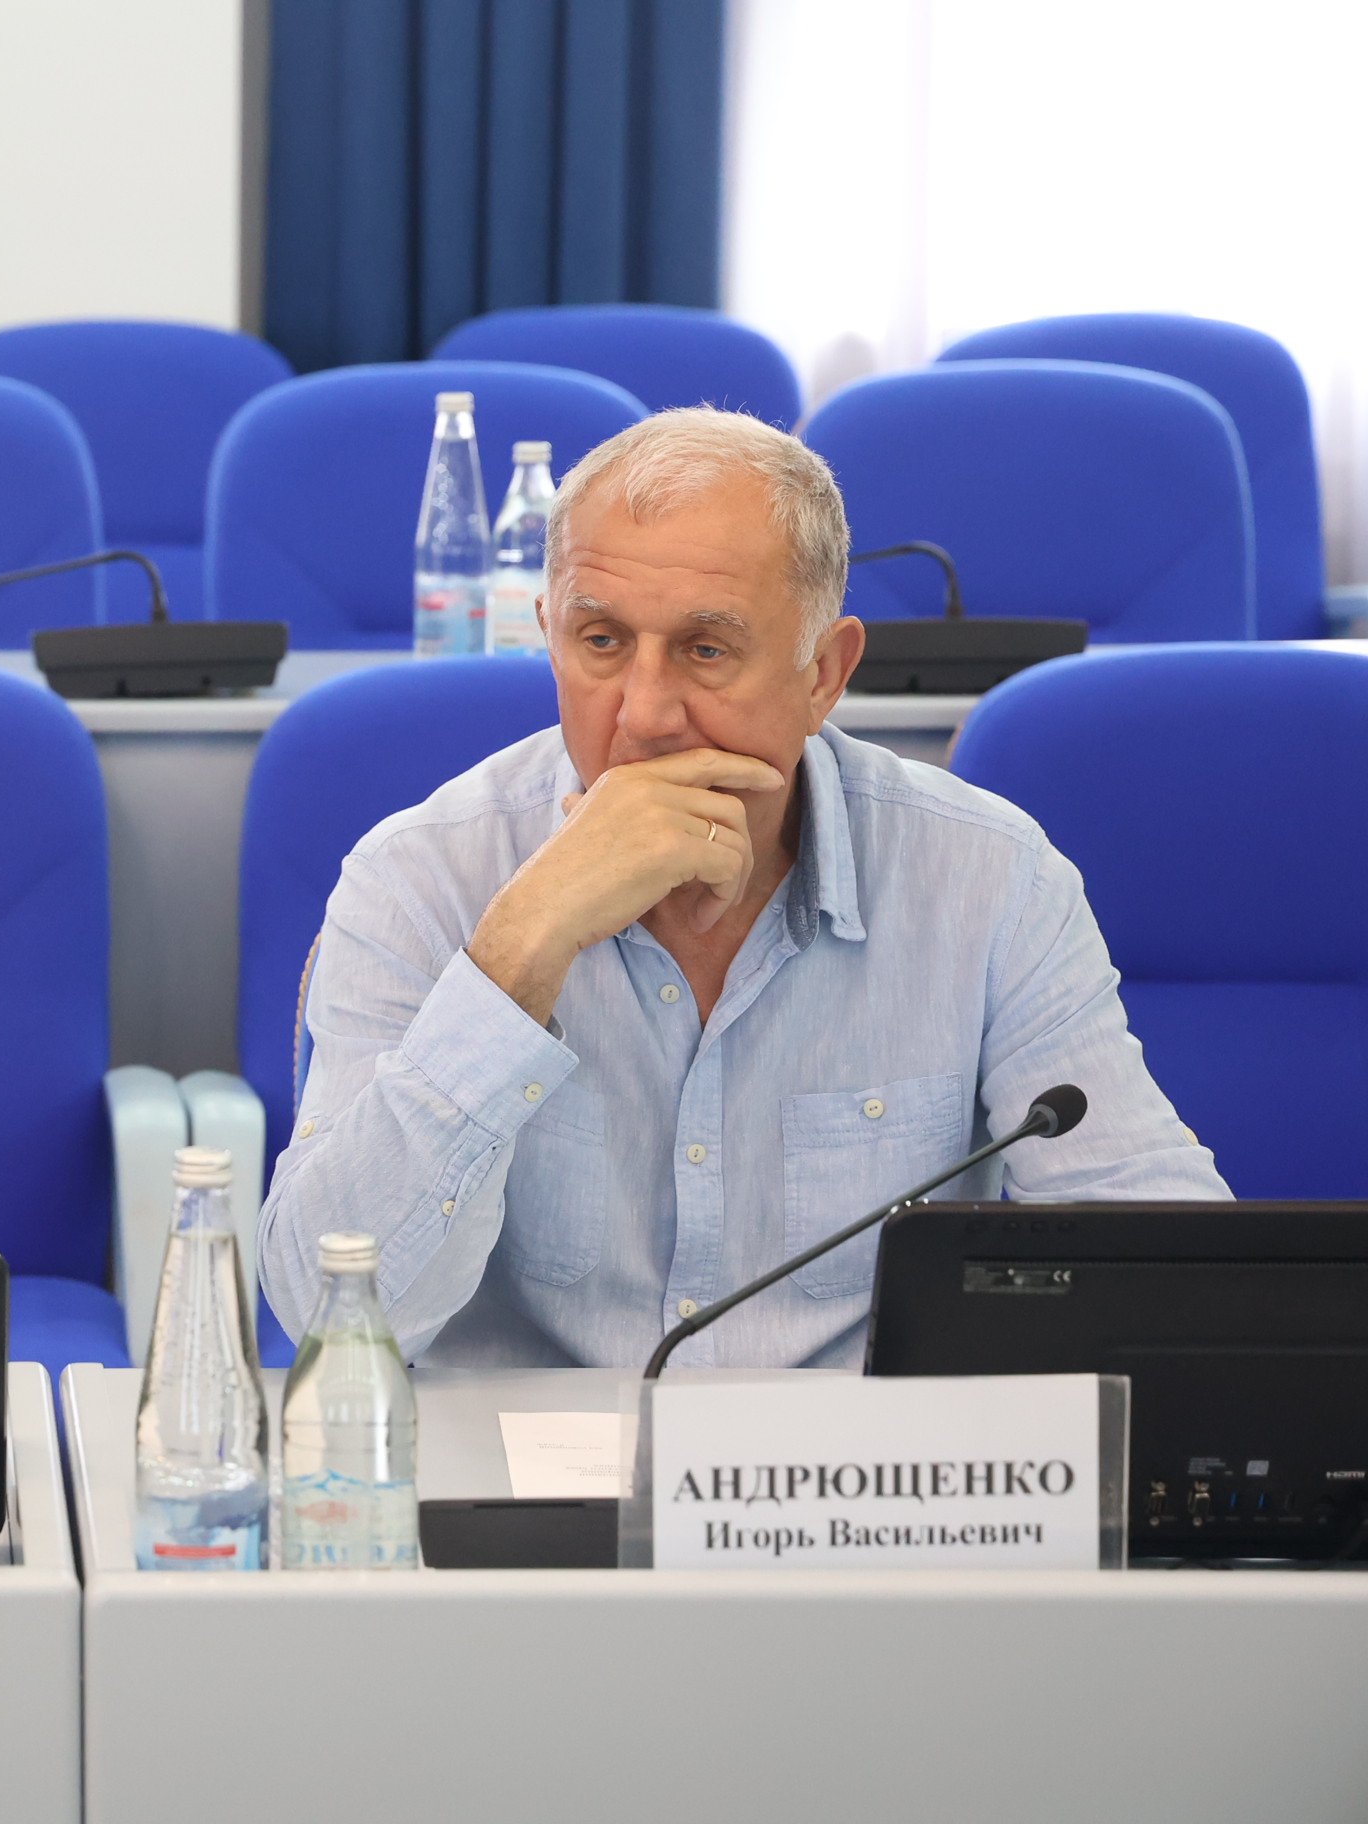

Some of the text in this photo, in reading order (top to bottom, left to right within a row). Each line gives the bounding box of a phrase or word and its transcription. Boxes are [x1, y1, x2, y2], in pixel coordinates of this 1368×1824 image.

[673, 1459, 1076, 1508] АНДРЮЩЕНКО
[704, 1517, 1045, 1557] Игорь Васильевич
